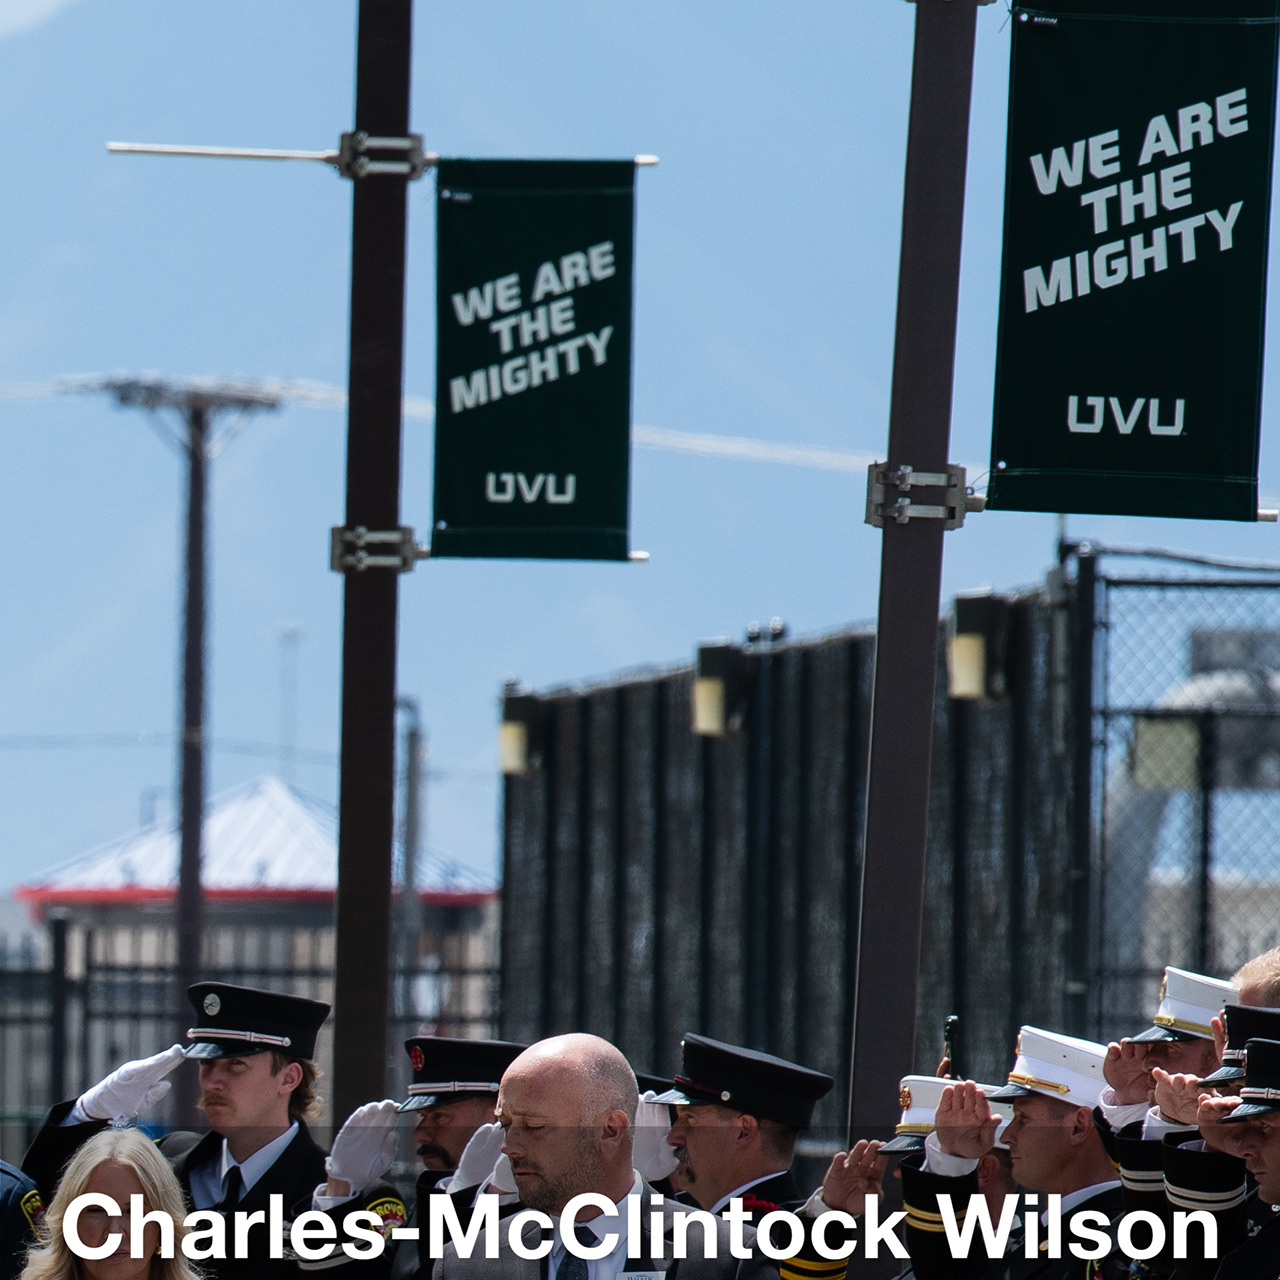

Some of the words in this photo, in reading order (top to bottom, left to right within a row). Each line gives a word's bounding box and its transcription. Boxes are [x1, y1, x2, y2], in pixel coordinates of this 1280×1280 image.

[1029, 129, 1120, 195] WE
[1138, 88, 1249, 166] ARE
[1081, 161, 1192, 235] THE
[452, 273, 521, 327] WE
[532, 242, 616, 303] ARE
[1023, 201, 1244, 314] MIGHTY
[490, 298, 576, 354] THE
[449, 327, 613, 413] MIGHTY
[1067, 395, 1185, 436] UVU
[485, 472, 576, 504] UVU
